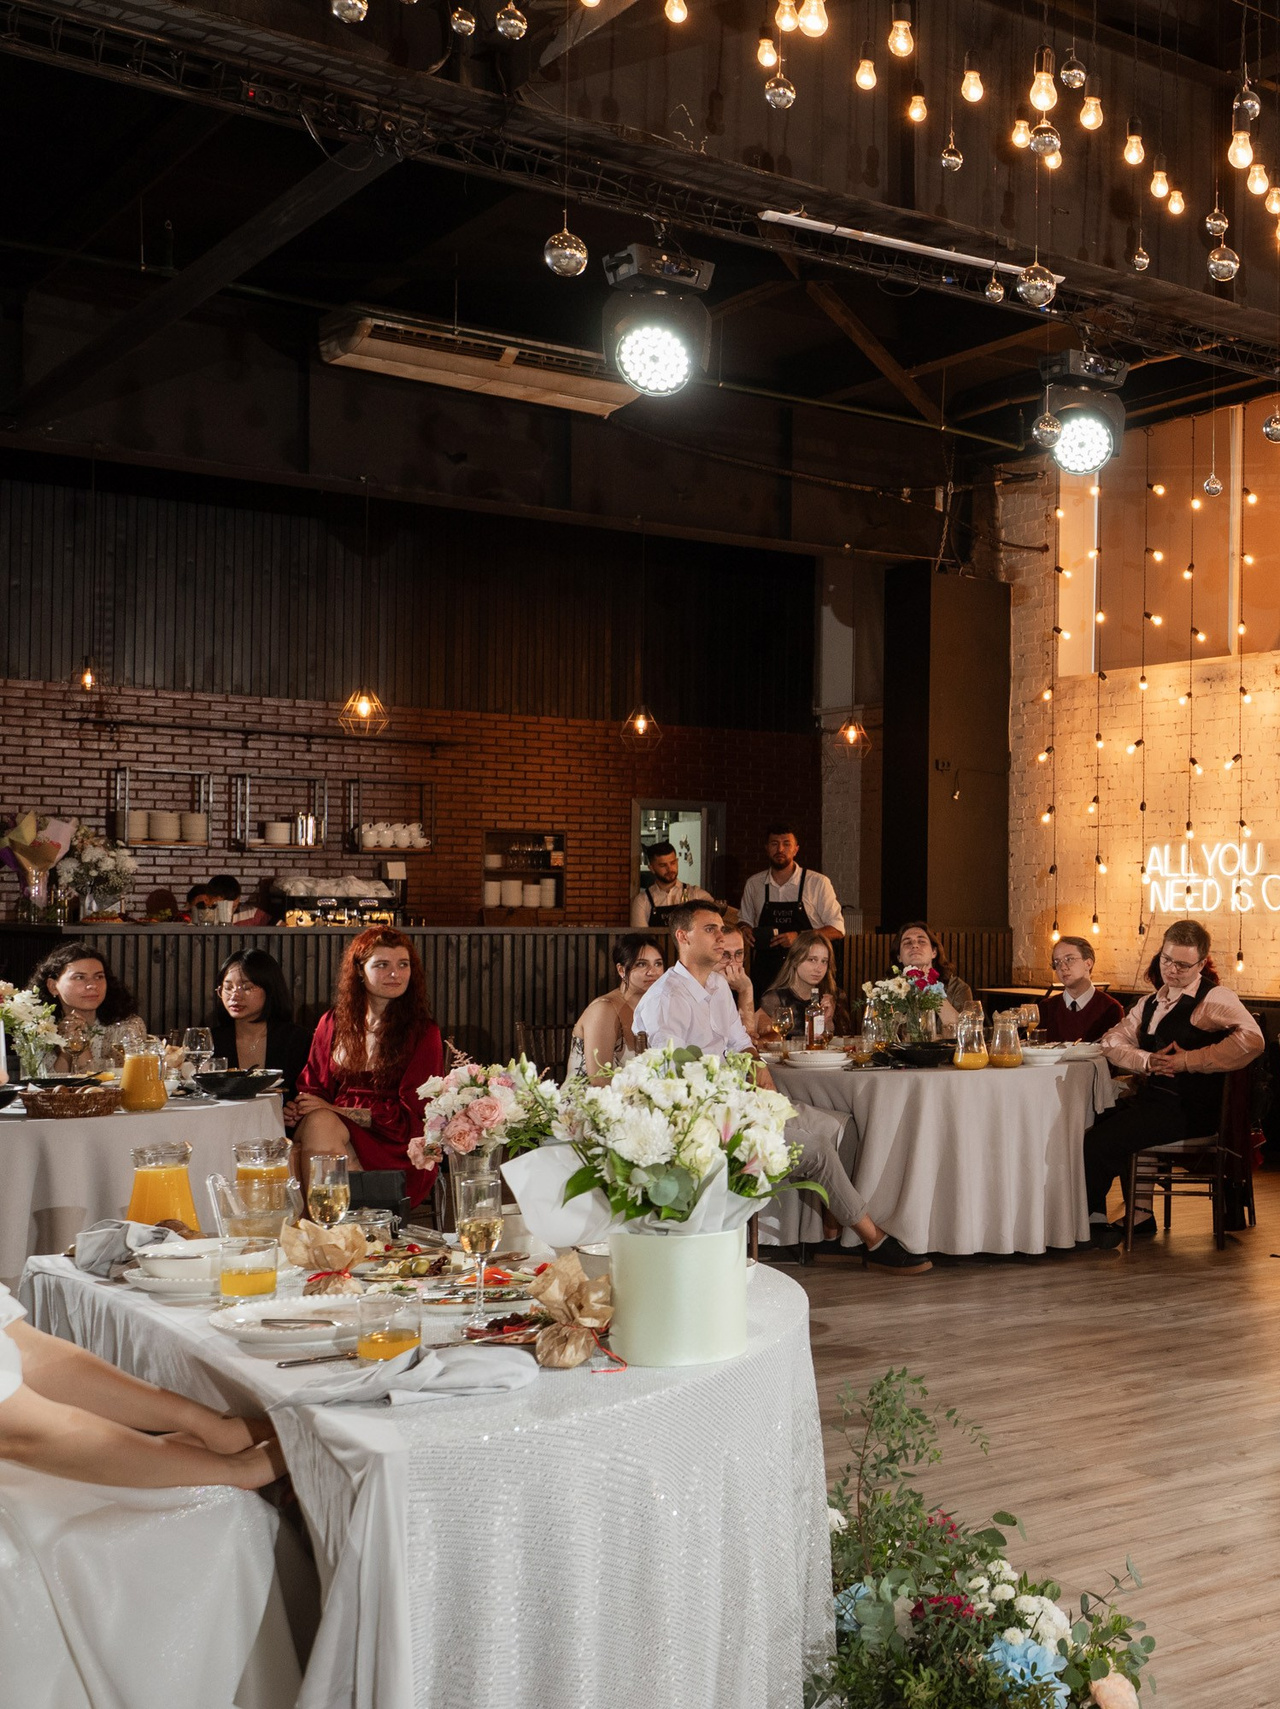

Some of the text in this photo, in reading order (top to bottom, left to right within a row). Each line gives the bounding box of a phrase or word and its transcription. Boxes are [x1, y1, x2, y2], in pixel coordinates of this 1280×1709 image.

[1146, 843, 1263, 878] ALL YOU
[1149, 879, 1255, 913] NEED IS
